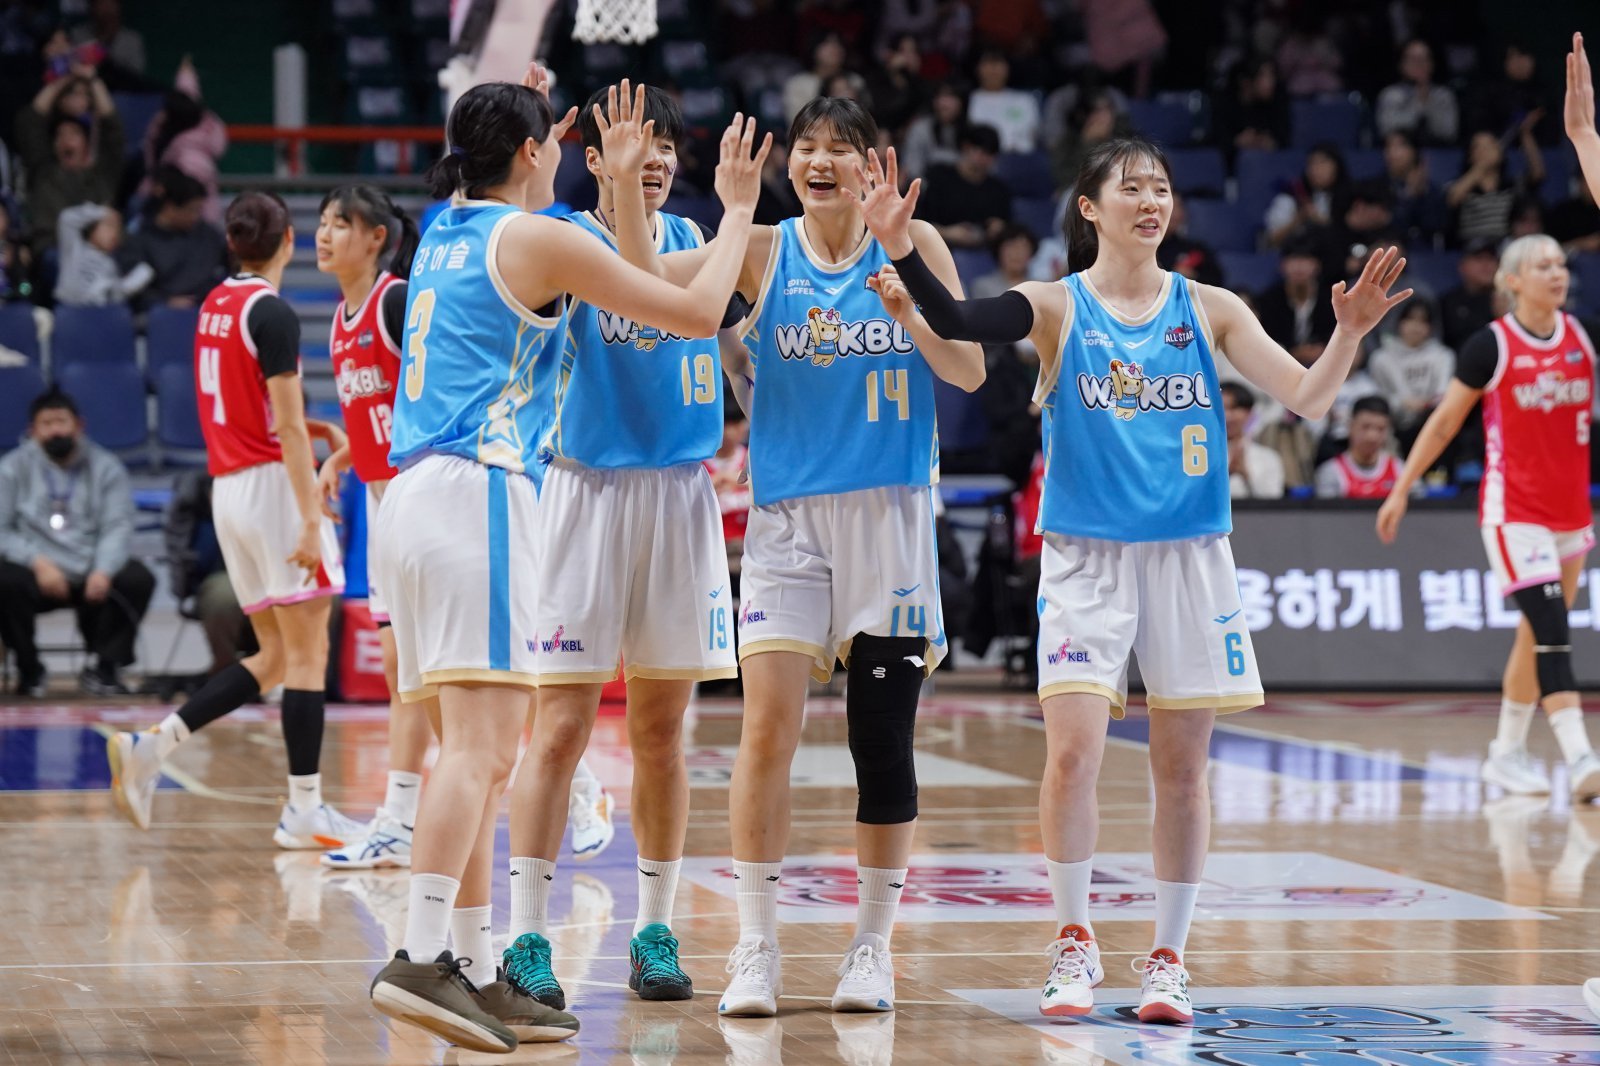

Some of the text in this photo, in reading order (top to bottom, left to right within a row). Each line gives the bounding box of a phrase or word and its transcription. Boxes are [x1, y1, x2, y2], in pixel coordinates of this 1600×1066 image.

[413, 240, 470, 278] 강이슬
[783, 286, 816, 296] COFFEE
[405, 287, 437, 402] 3
[1165, 330, 1195, 343] ALL STAR
[199, 346, 227, 426] 4
[340, 366, 391, 400] KBL
[681, 353, 716, 406] 19
[866, 369, 910, 423] 14
[1181, 423, 1209, 477] 6
[708, 607, 728, 651] 19
[889, 605, 926, 638] 14
[1047, 649, 1092, 665] WKBL
[1224, 632, 1246, 677] 6
